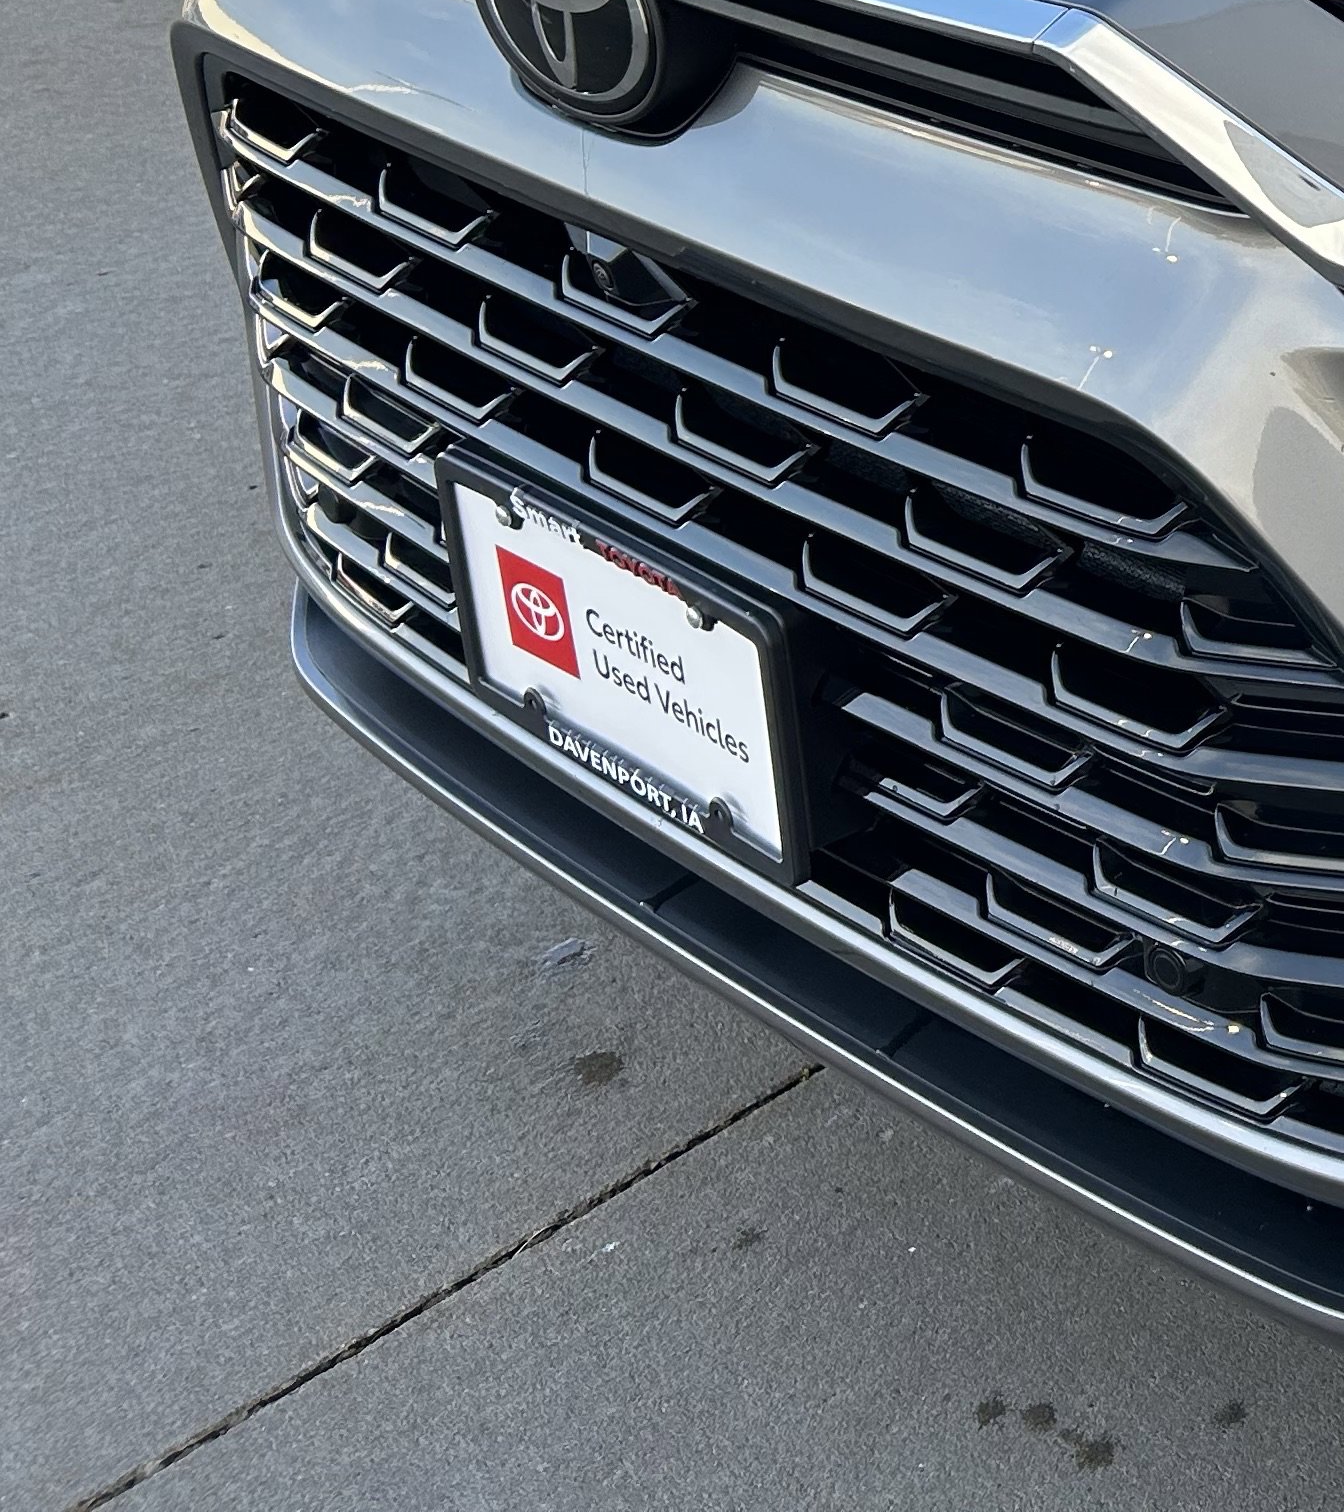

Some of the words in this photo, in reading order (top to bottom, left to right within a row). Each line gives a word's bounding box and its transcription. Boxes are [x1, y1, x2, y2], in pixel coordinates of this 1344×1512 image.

[510, 488, 582, 545] Smart
[585, 608, 686, 685] Certified
[592, 648, 652, 704] Used
[653, 682, 750, 763] Vehicles
[548, 725, 678, 819] DAVENPORT,
[681, 803, 705, 834] IA
